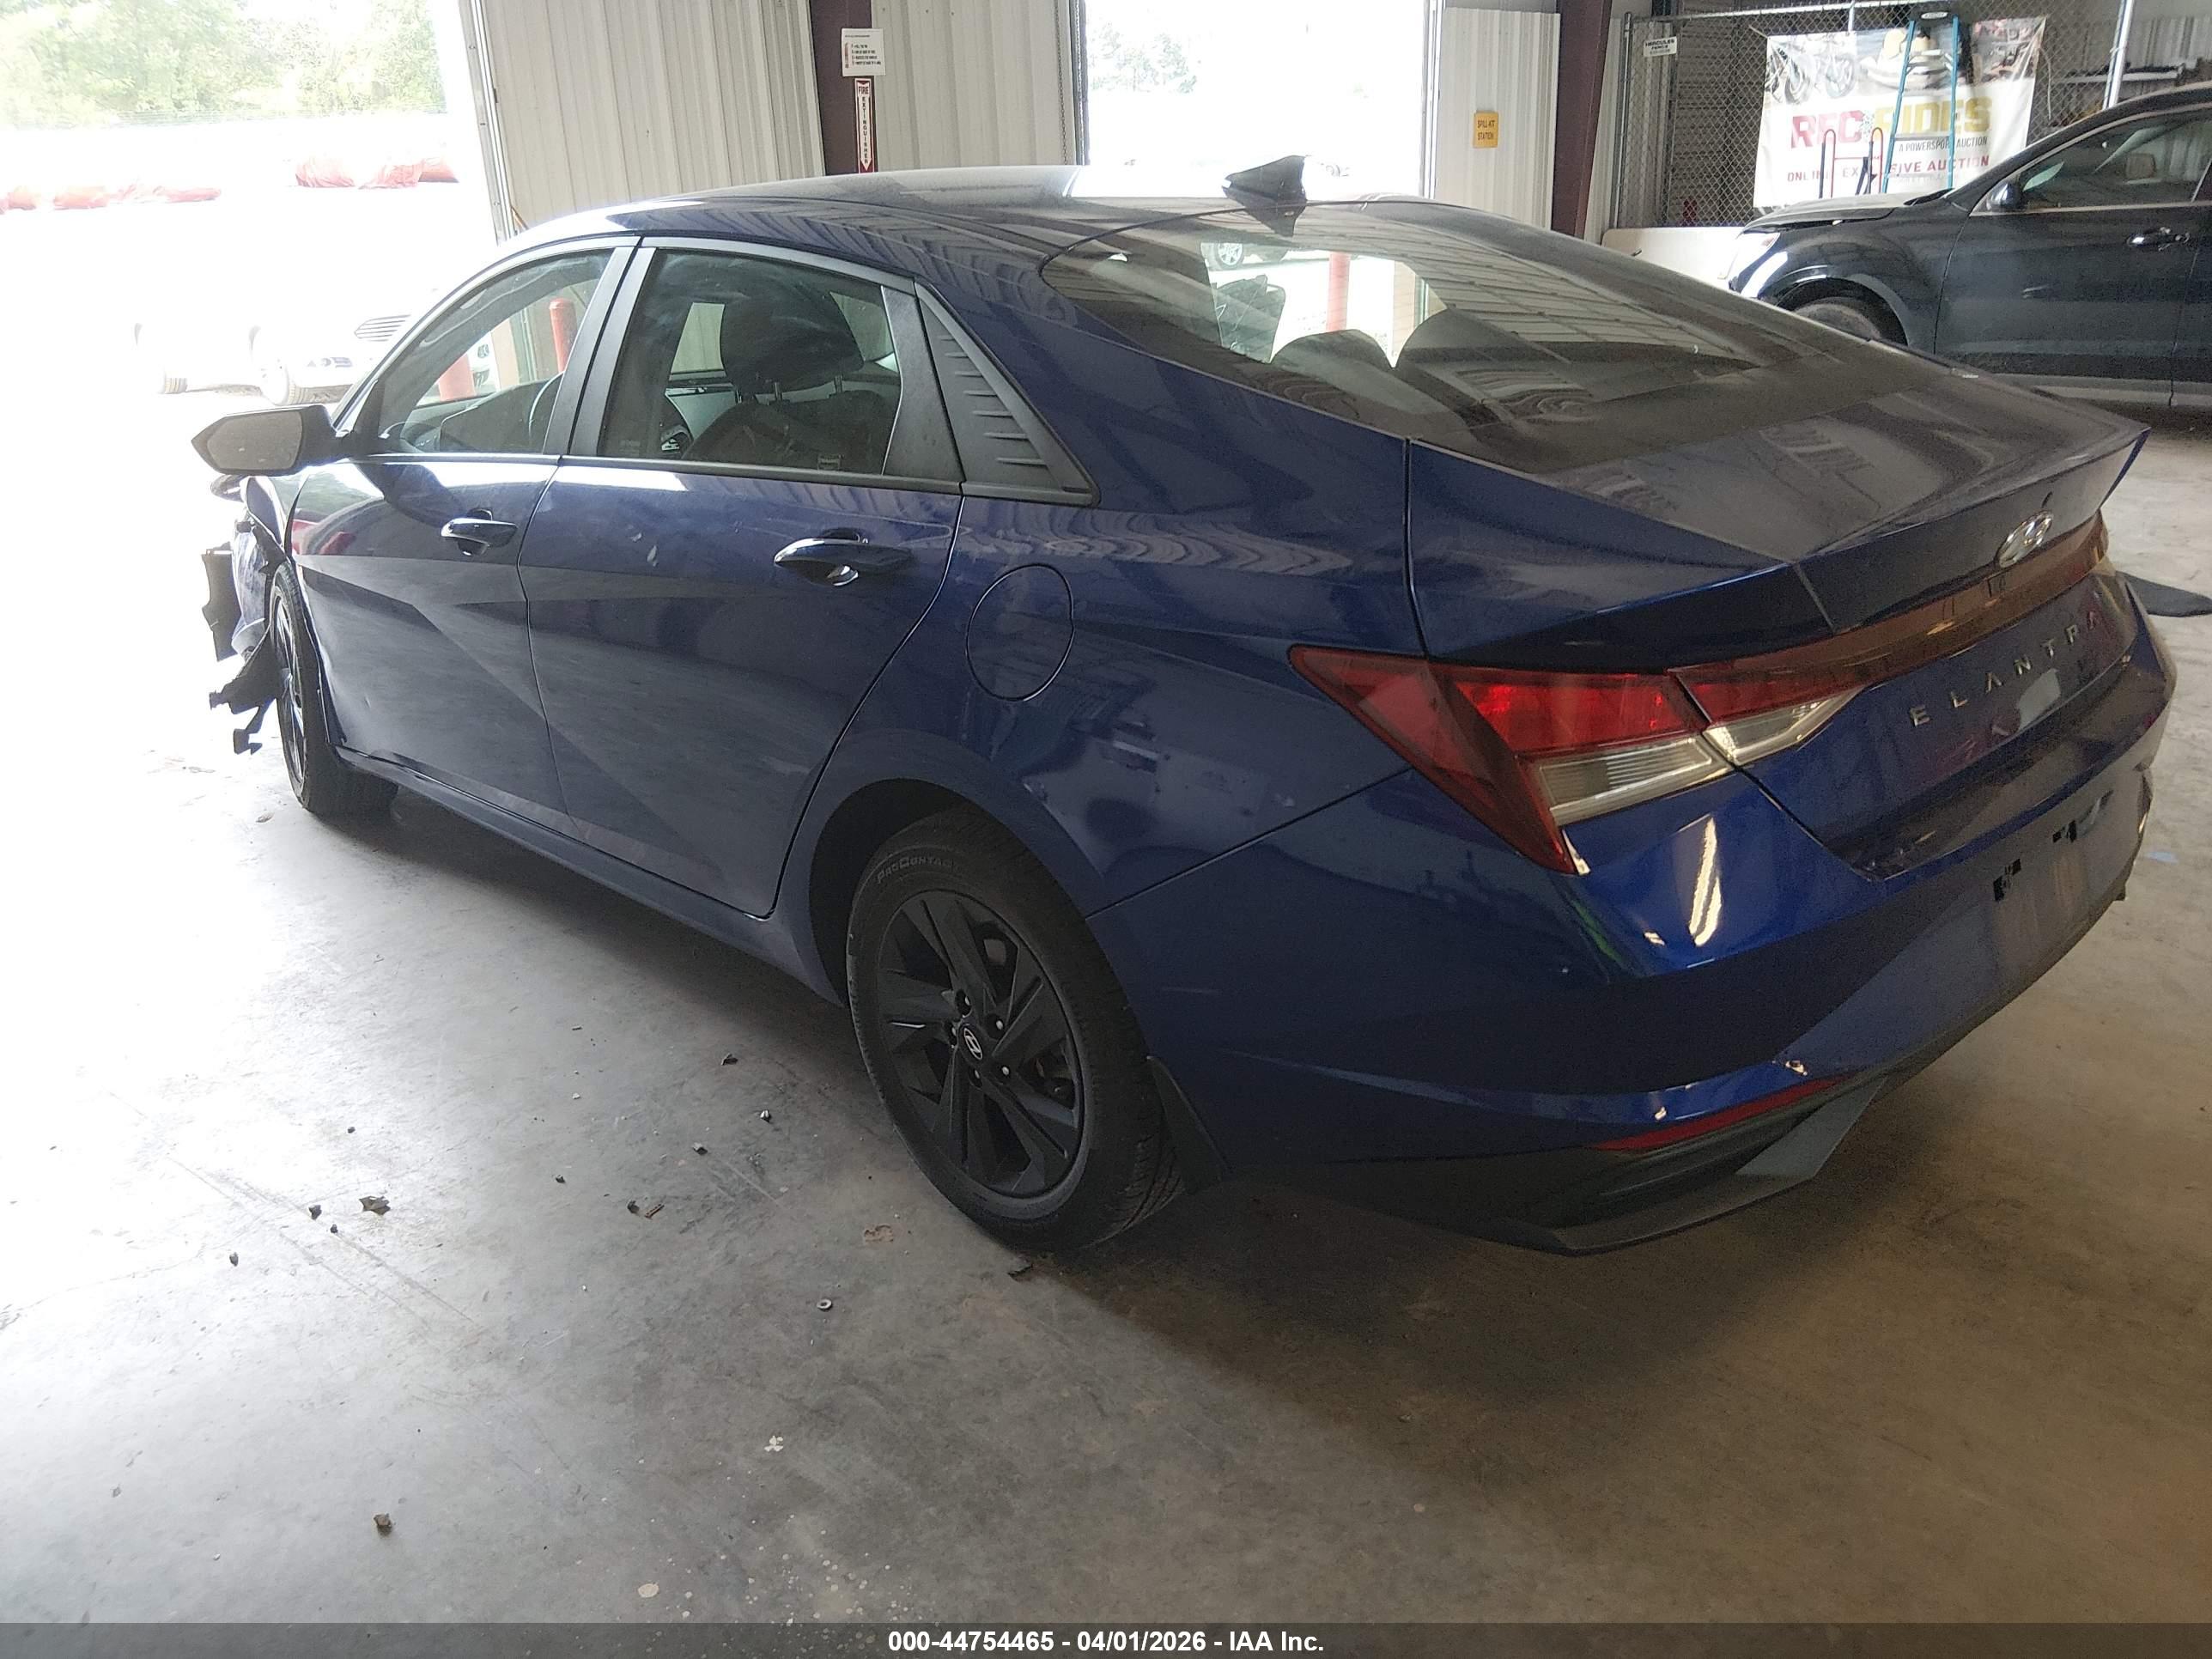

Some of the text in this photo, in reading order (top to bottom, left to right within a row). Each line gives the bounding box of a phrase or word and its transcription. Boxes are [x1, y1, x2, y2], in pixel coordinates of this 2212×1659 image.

[1899, 136, 1988, 152] A POWERSPOR AUCTION
